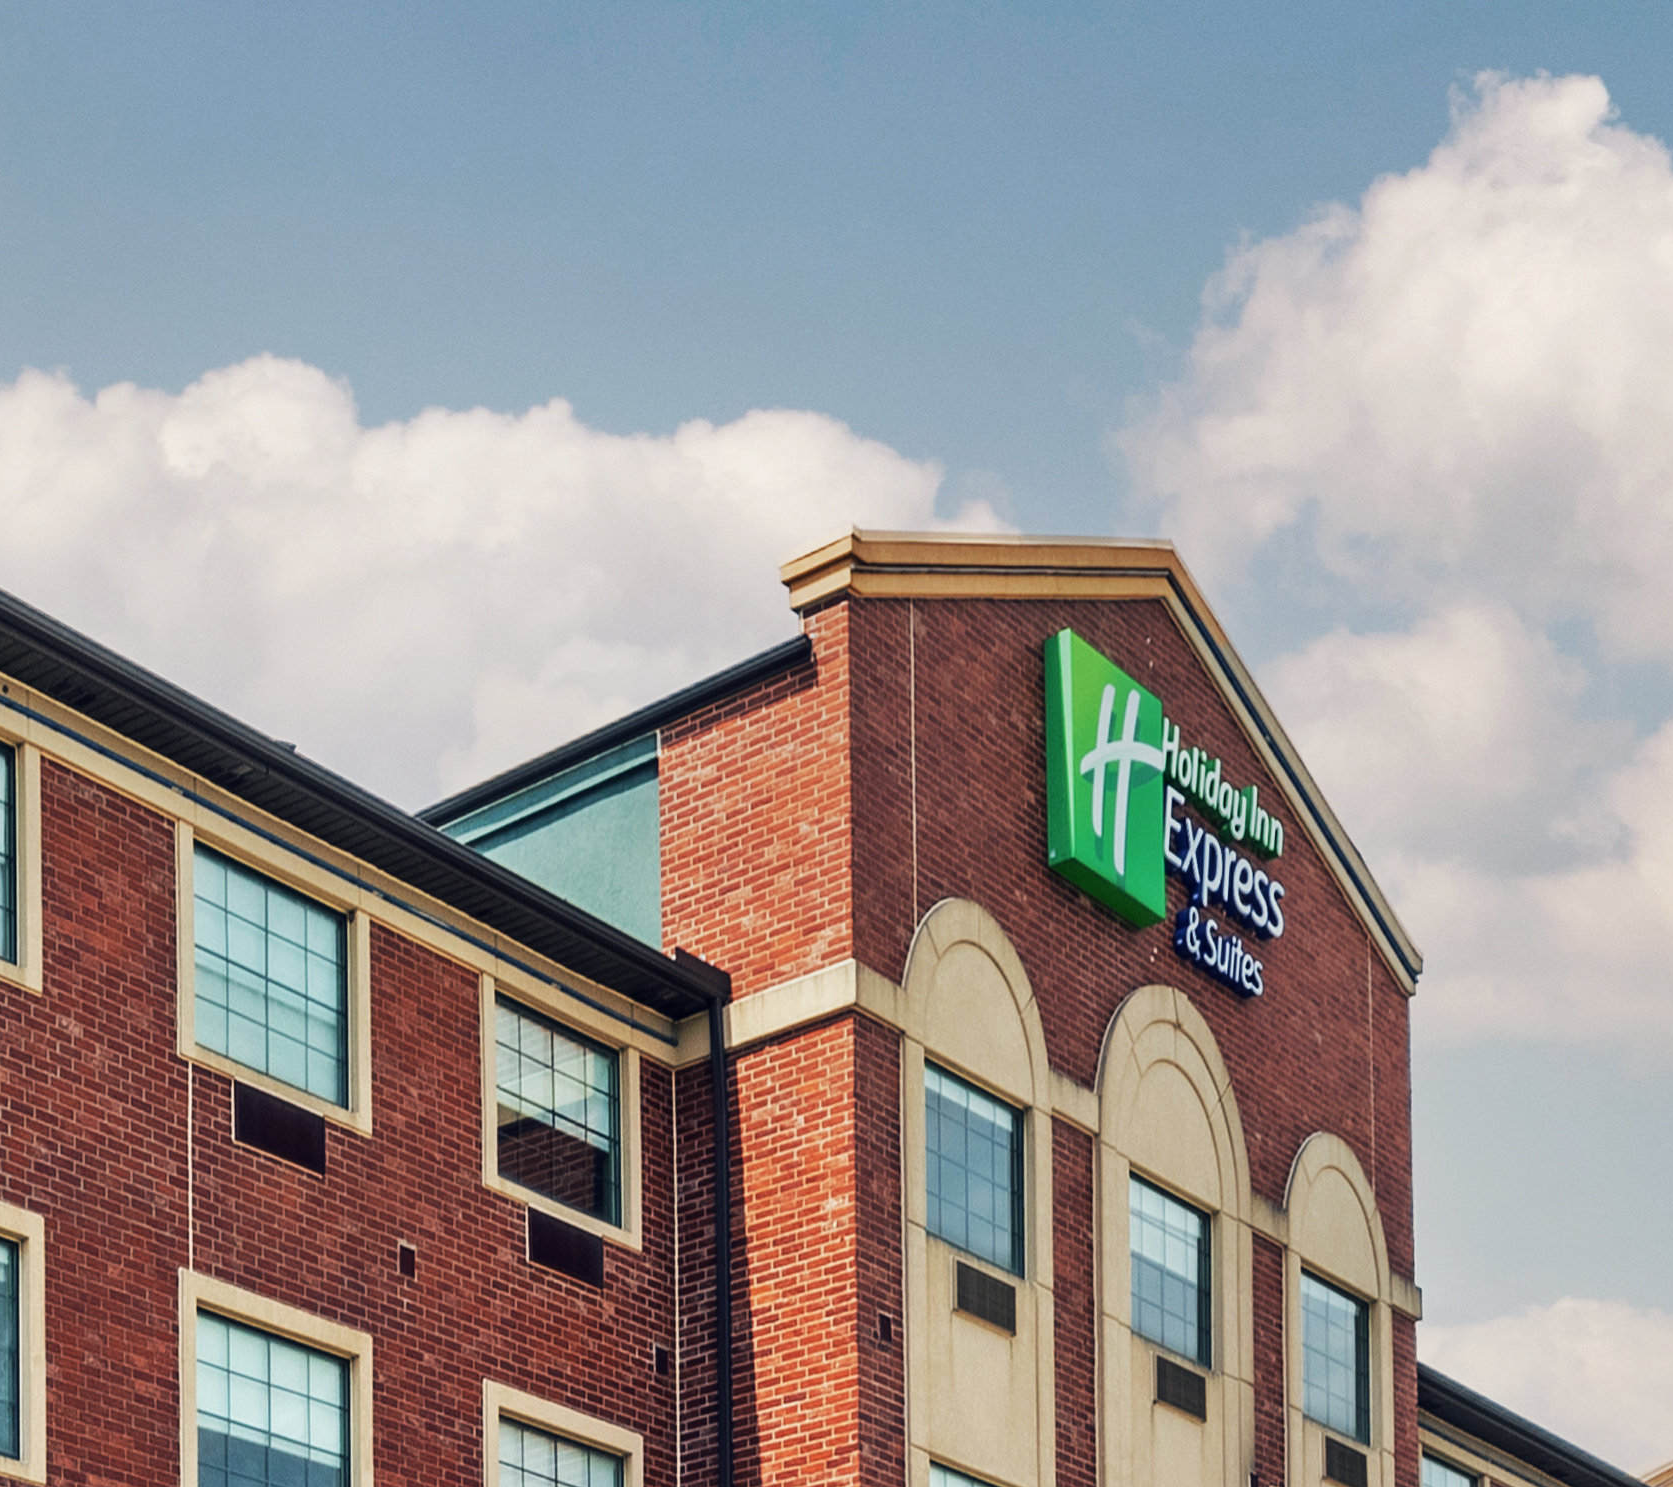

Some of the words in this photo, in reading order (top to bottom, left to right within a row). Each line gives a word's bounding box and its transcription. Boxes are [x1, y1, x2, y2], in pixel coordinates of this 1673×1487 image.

[1162, 717, 1247, 840] Holiday
[1250, 785, 1284, 856] Inn
[1164, 784, 1285, 937] Express
[1186, 906, 1200, 961] &
[1203, 919, 1264, 996] Suites
